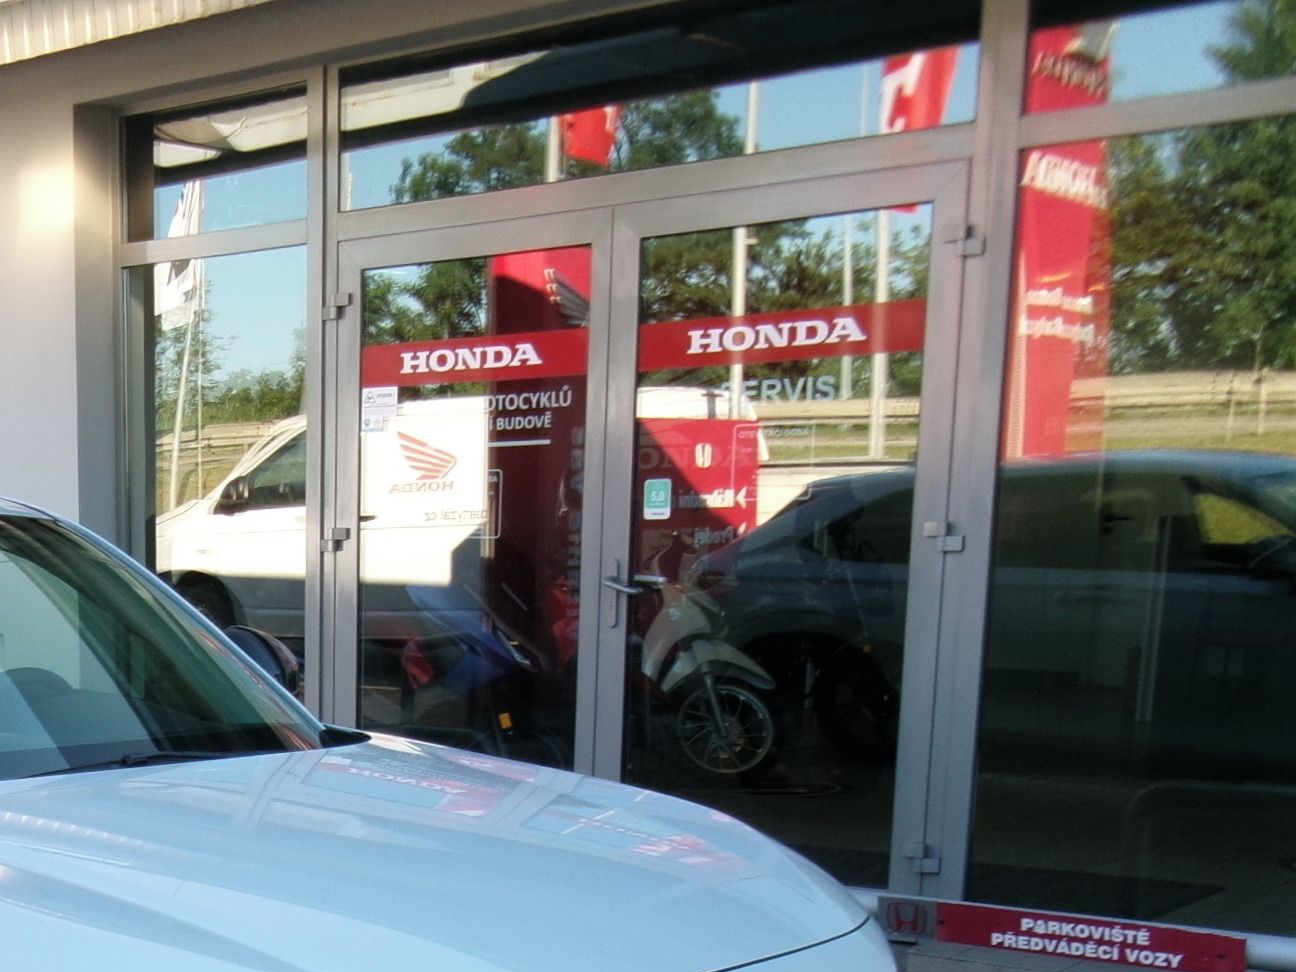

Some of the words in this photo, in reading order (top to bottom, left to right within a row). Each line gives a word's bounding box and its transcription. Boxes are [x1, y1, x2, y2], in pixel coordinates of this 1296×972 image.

[687, 317, 867, 354] HONDA
[400, 343, 543, 374] HONDA
[484, 384, 573, 412] OTOCYKLŮ
[495, 411, 552, 431] BUDOVĚ
[990, 932, 1121, 961] PŘEDVÁDĚCÍ
[1124, 948, 1184, 969] VOZY
